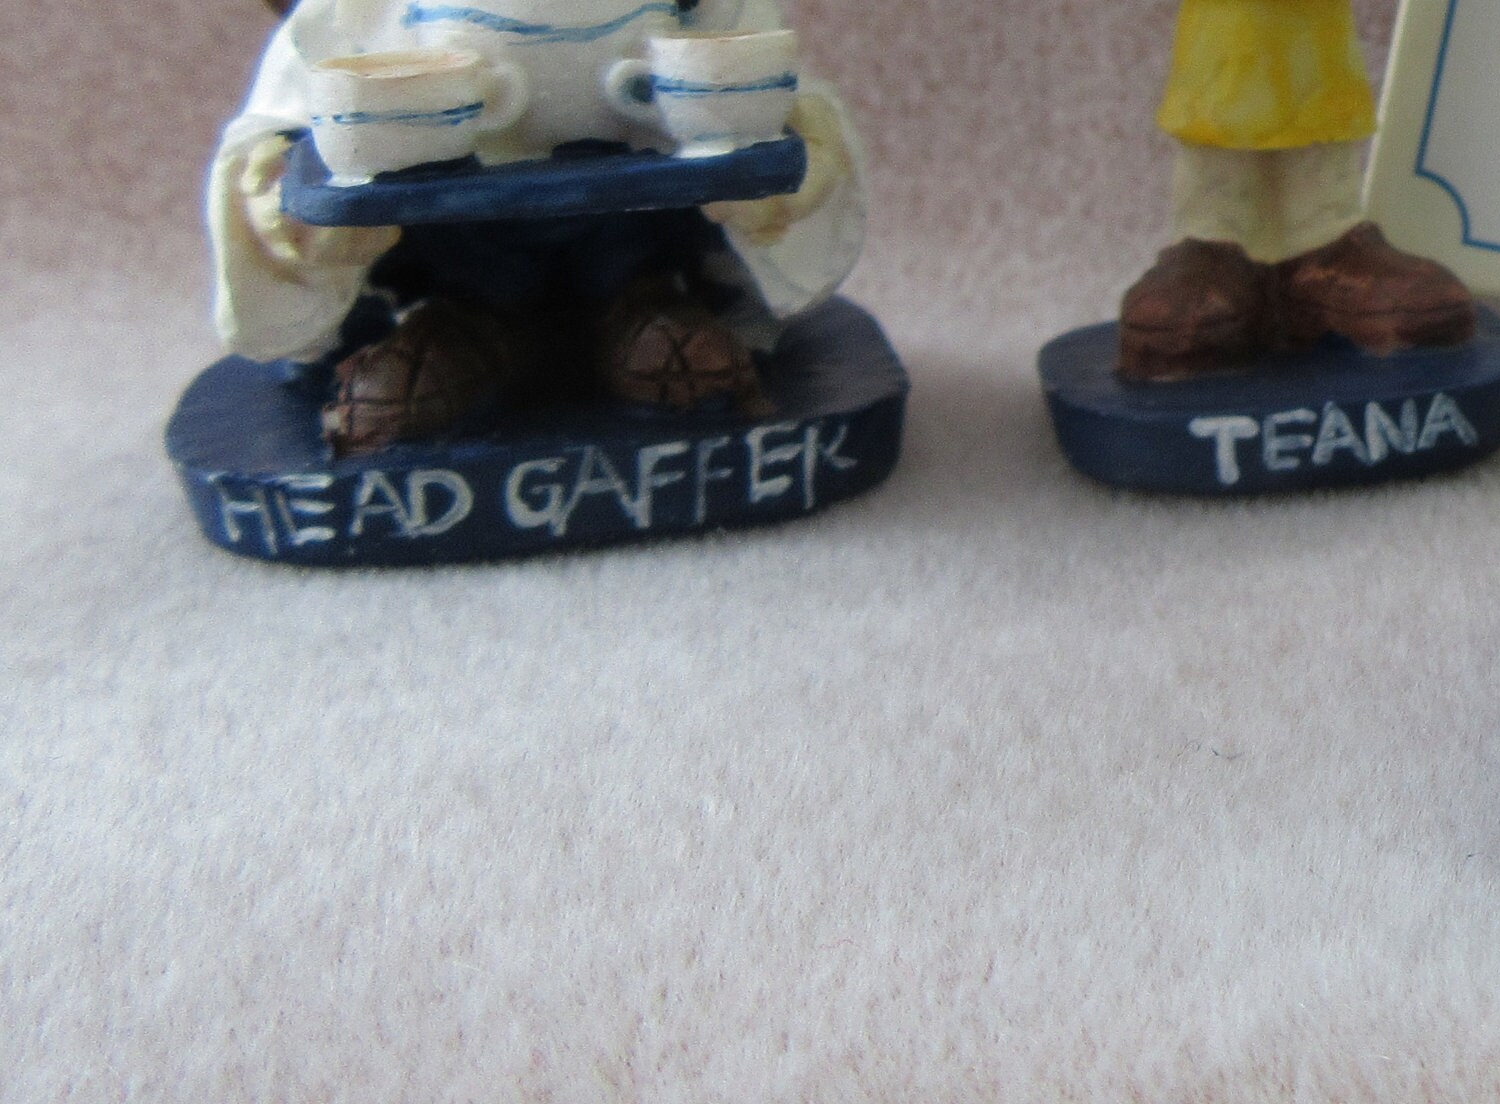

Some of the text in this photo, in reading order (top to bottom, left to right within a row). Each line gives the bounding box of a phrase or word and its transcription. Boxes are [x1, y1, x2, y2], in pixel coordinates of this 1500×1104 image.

[207, 417, 859, 555] HEAD GAFFER
[1189, 393, 1479, 485] TEANA
